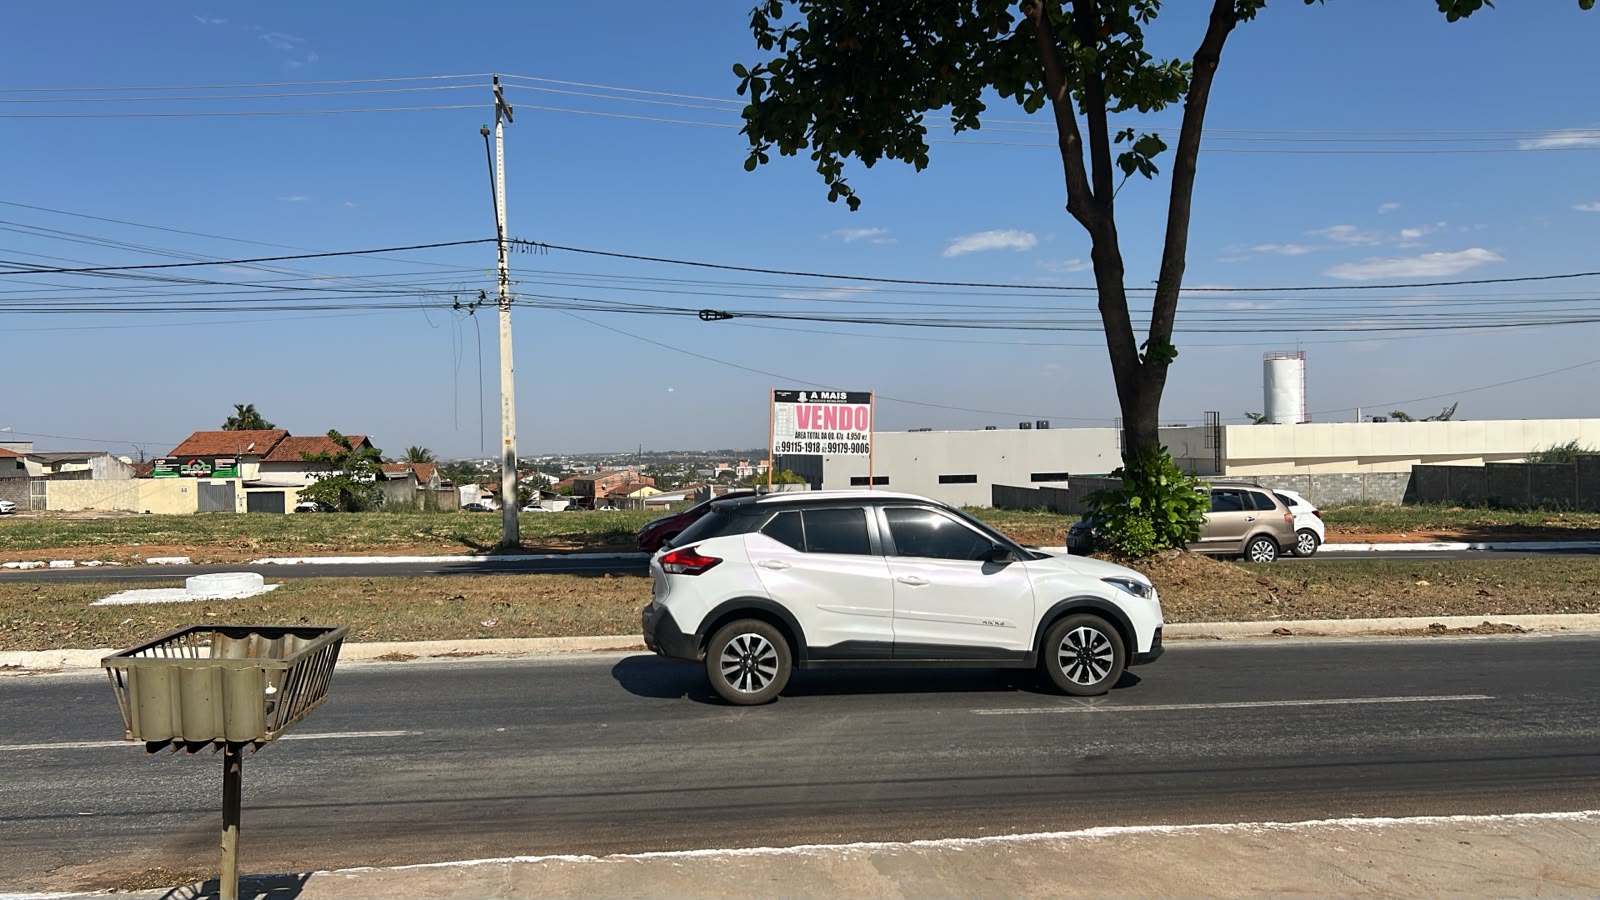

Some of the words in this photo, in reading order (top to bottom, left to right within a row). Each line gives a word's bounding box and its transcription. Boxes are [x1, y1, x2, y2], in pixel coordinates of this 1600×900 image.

[821, 392, 847, 400] MAIS
[796, 405, 868, 431] VENDO
[782, 441, 820, 453] 99115-1918
[828, 442, 869, 454] 99179-9006
